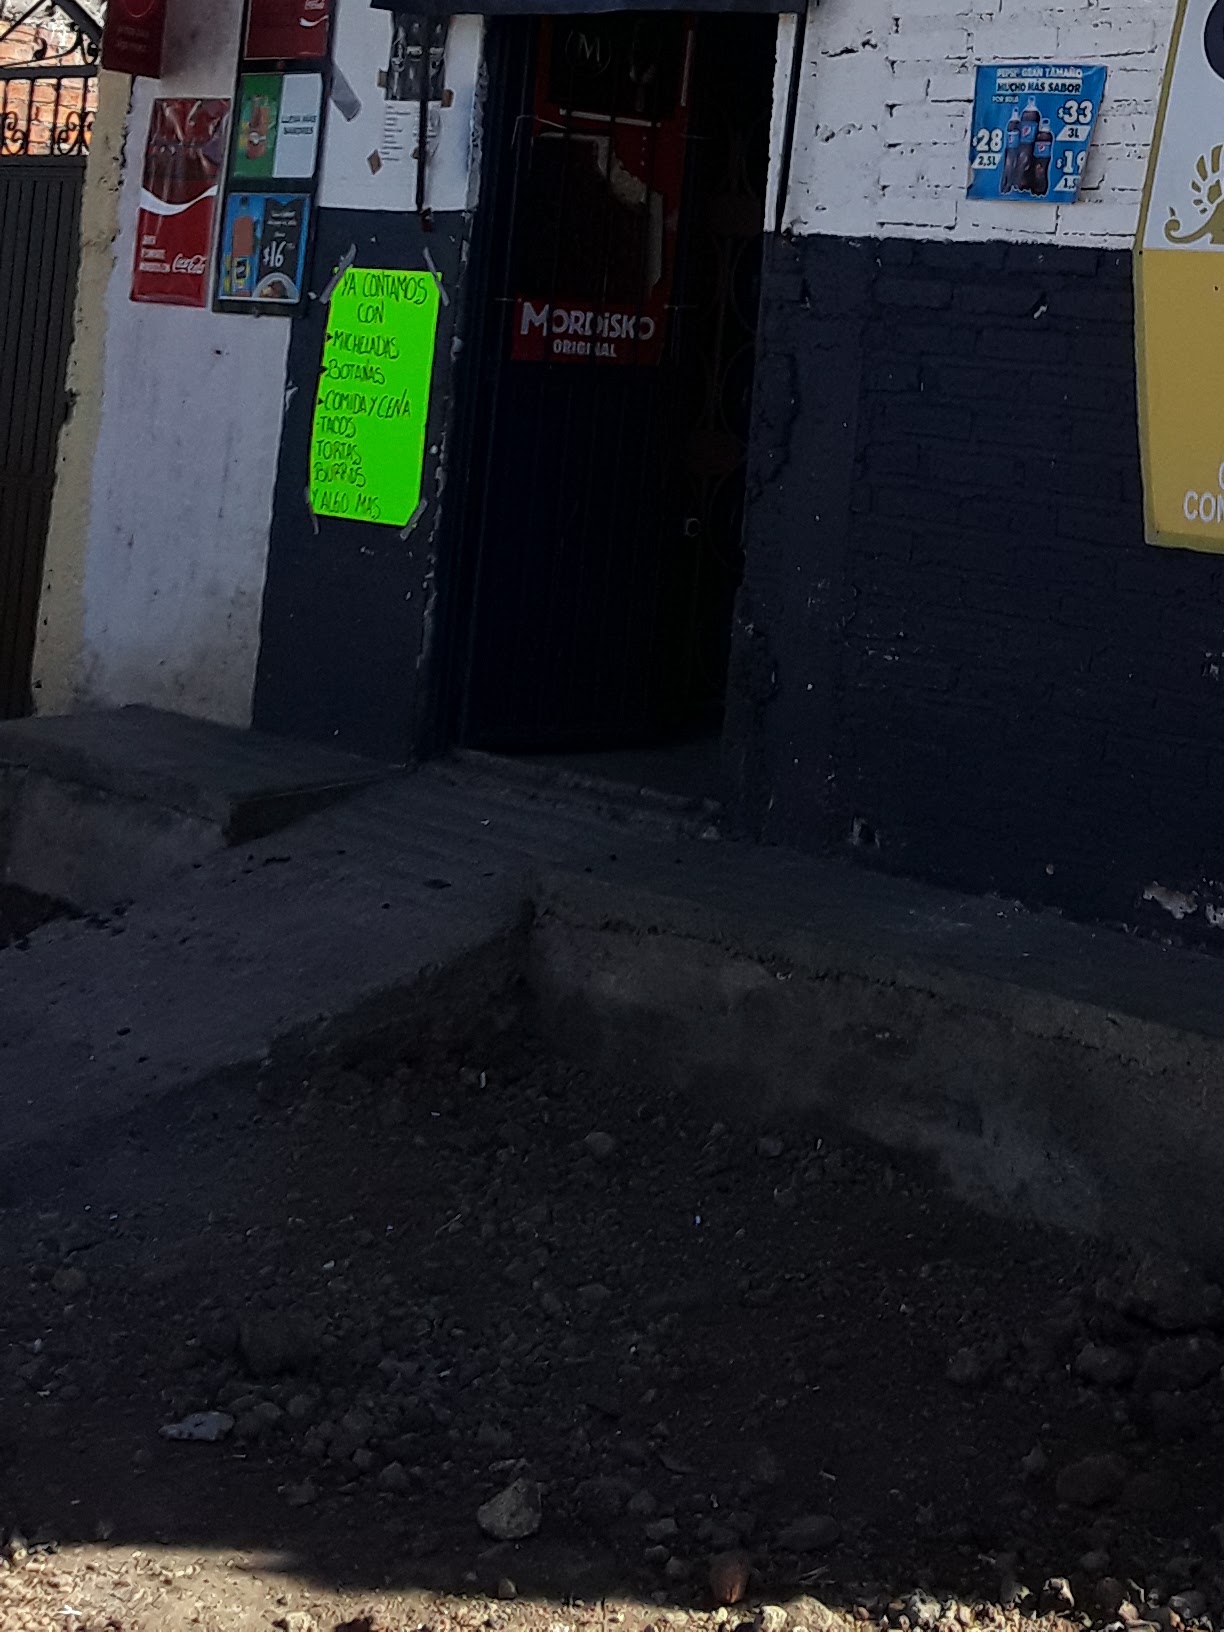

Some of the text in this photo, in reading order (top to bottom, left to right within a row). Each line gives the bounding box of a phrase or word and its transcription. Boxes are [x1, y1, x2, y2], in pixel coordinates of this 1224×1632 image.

[996, 82, 1027, 93] MUCHO
[1048, 82, 1082, 94] SABOR
[341, 271, 428, 305] YA CONTAMOS
[357, 301, 384, 324] CON
[332, 329, 400, 360] MICHELADAS
[324, 388, 411, 419] COMIDA Y CENA
[316, 439, 362, 466] TORTAS
